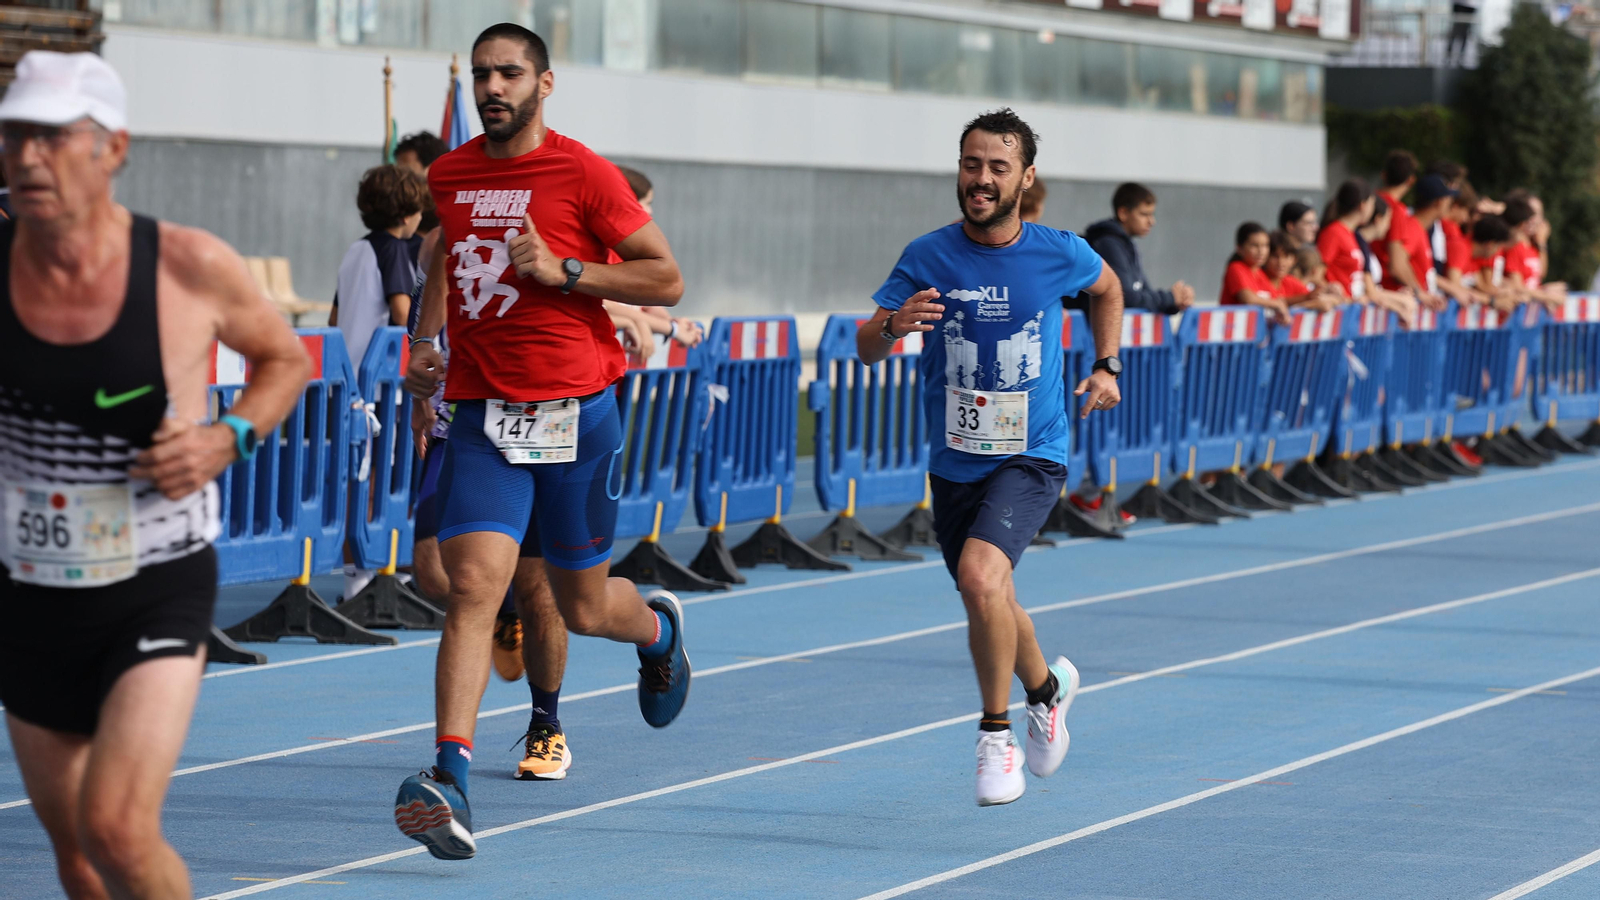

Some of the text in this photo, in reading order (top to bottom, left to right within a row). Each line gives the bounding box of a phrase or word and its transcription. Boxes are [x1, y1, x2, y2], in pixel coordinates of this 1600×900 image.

[475, 190, 532, 204] CARRERA
[470, 203, 527, 217] POPULAR
[978, 286, 1008, 301] XLI
[977, 301, 1009, 309] Carrera
[977, 308, 1010, 317] Popular
[958, 406, 979, 430] 33
[496, 417, 537, 440] 147
[18, 510, 71, 549] 596
